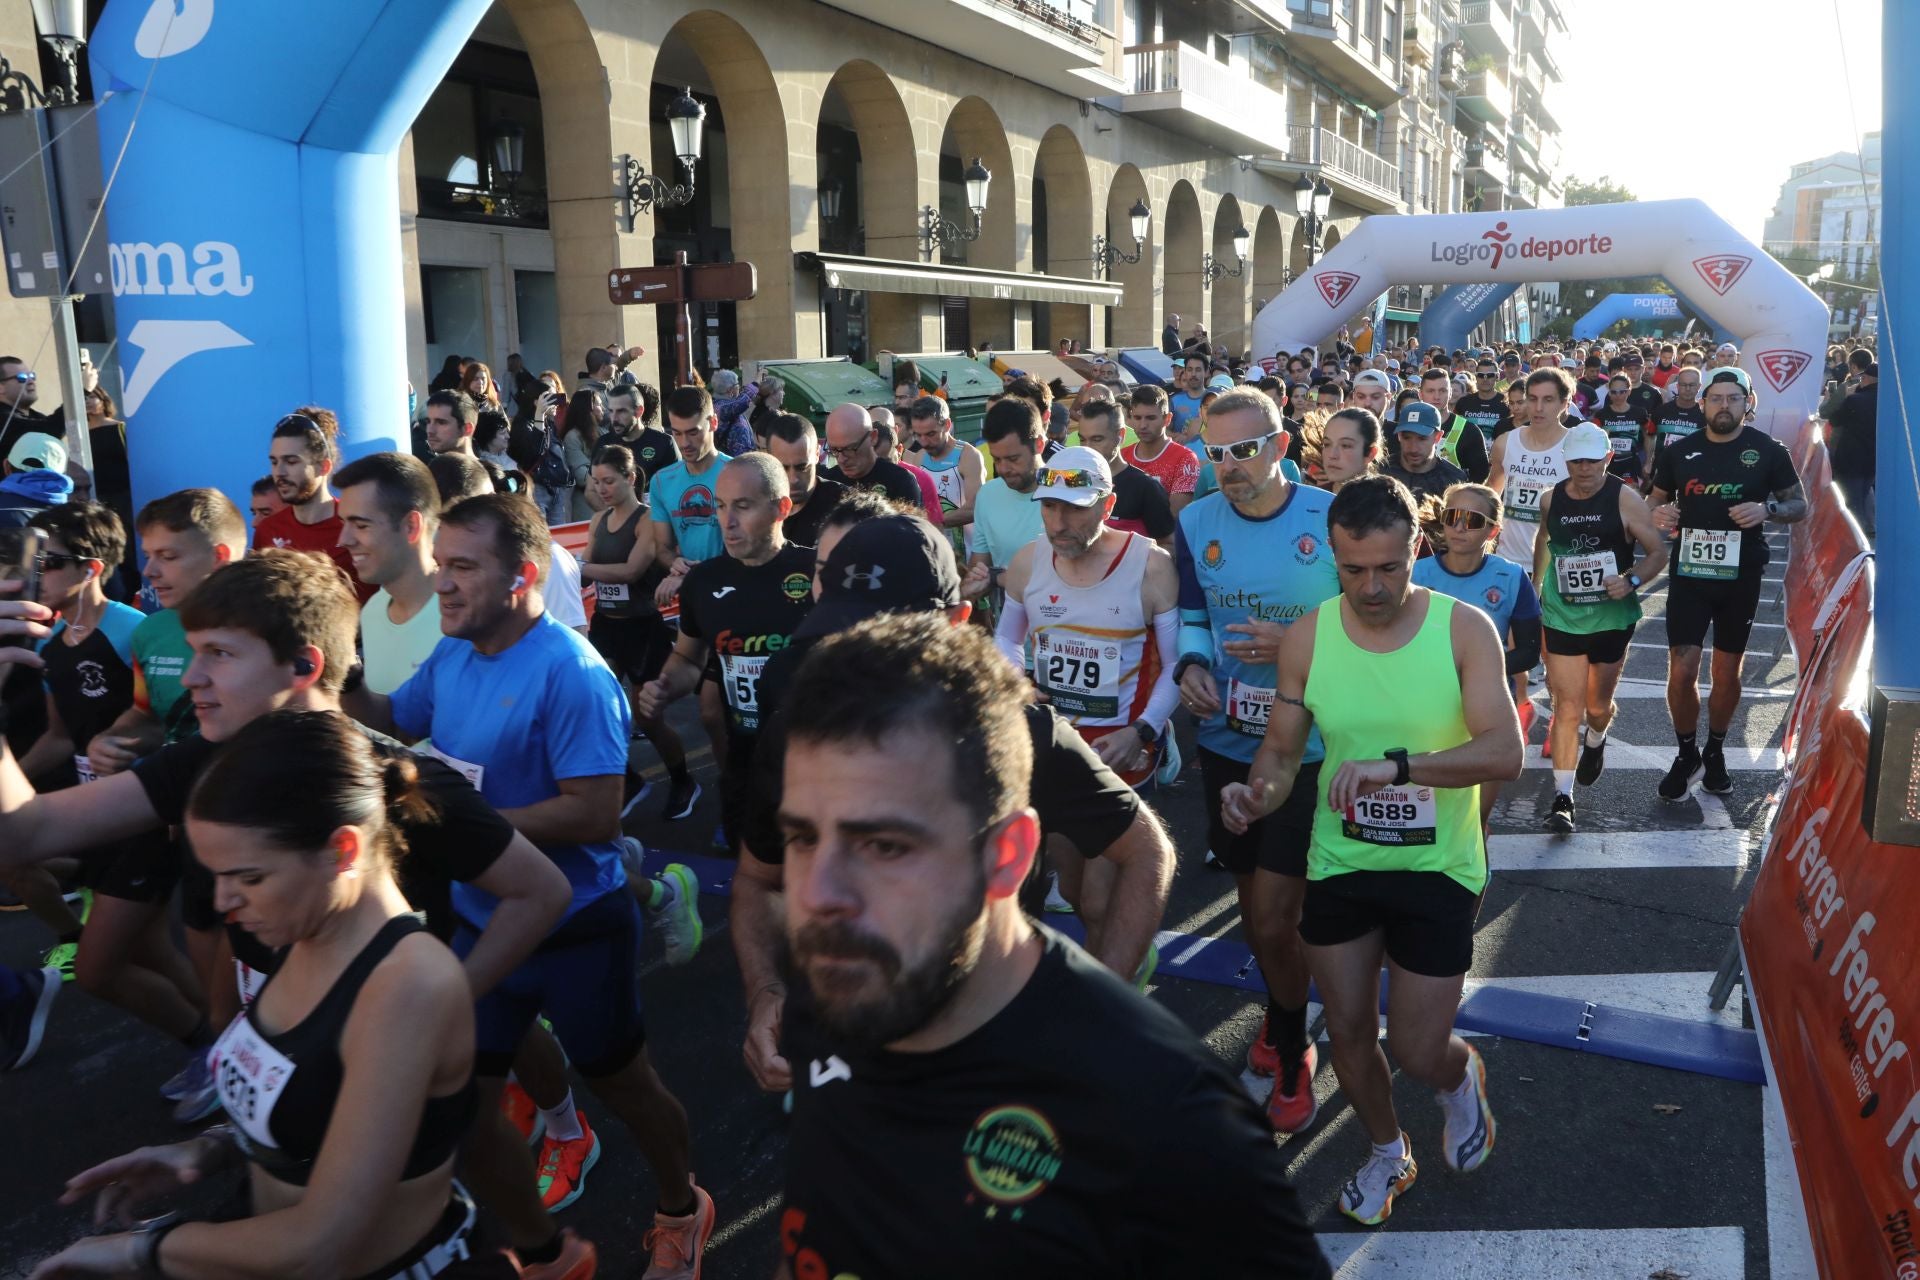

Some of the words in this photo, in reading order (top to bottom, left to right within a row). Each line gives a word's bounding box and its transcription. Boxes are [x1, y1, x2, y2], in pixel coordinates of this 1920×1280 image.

[1520, 233, 1612, 261] deporte
[1466, 283, 1498, 312] vocación
[1634, 298, 1678, 308] POWER
[1652, 307, 1677, 316] ADE
[1464, 410, 1500, 419] Fondistes
[1661, 418, 1698, 428] Fondistes
[1521, 454, 1527, 463] E
[1543, 456, 1551, 465] D
[1509, 465, 1557, 477] PALENCIA
[1684, 478, 1744, 497] ferrer
[1518, 488, 1538, 505] 57
[1691, 541, 1727, 560] 519
[1576, 560, 1602, 569] MARATÓN
[1568, 568, 1604, 588] 567
[1054, 643, 1062, 653] LA
[1065, 644, 1099, 660] MARATÓN
[738, 664, 746, 675] LA
[1049, 655, 1100, 689] 279
[1056, 683, 1091, 695] FRANCISCO
[1245, 691, 1251, 700] LA
[1374, 791, 1408, 802] MARATÓN
[1356, 801, 1417, 821] 1689
[1366, 819, 1386, 827] JUAN
[1372, 834, 1403, 842] NAVARRA
[1785, 806, 1845, 929] ferrer
[1829, 911, 1909, 1080] ferrer
[1850, 1052, 1874, 1104] center
[984, 1138, 1062, 1182] MARATÓN
[1883, 1208, 1918, 1267] sport
